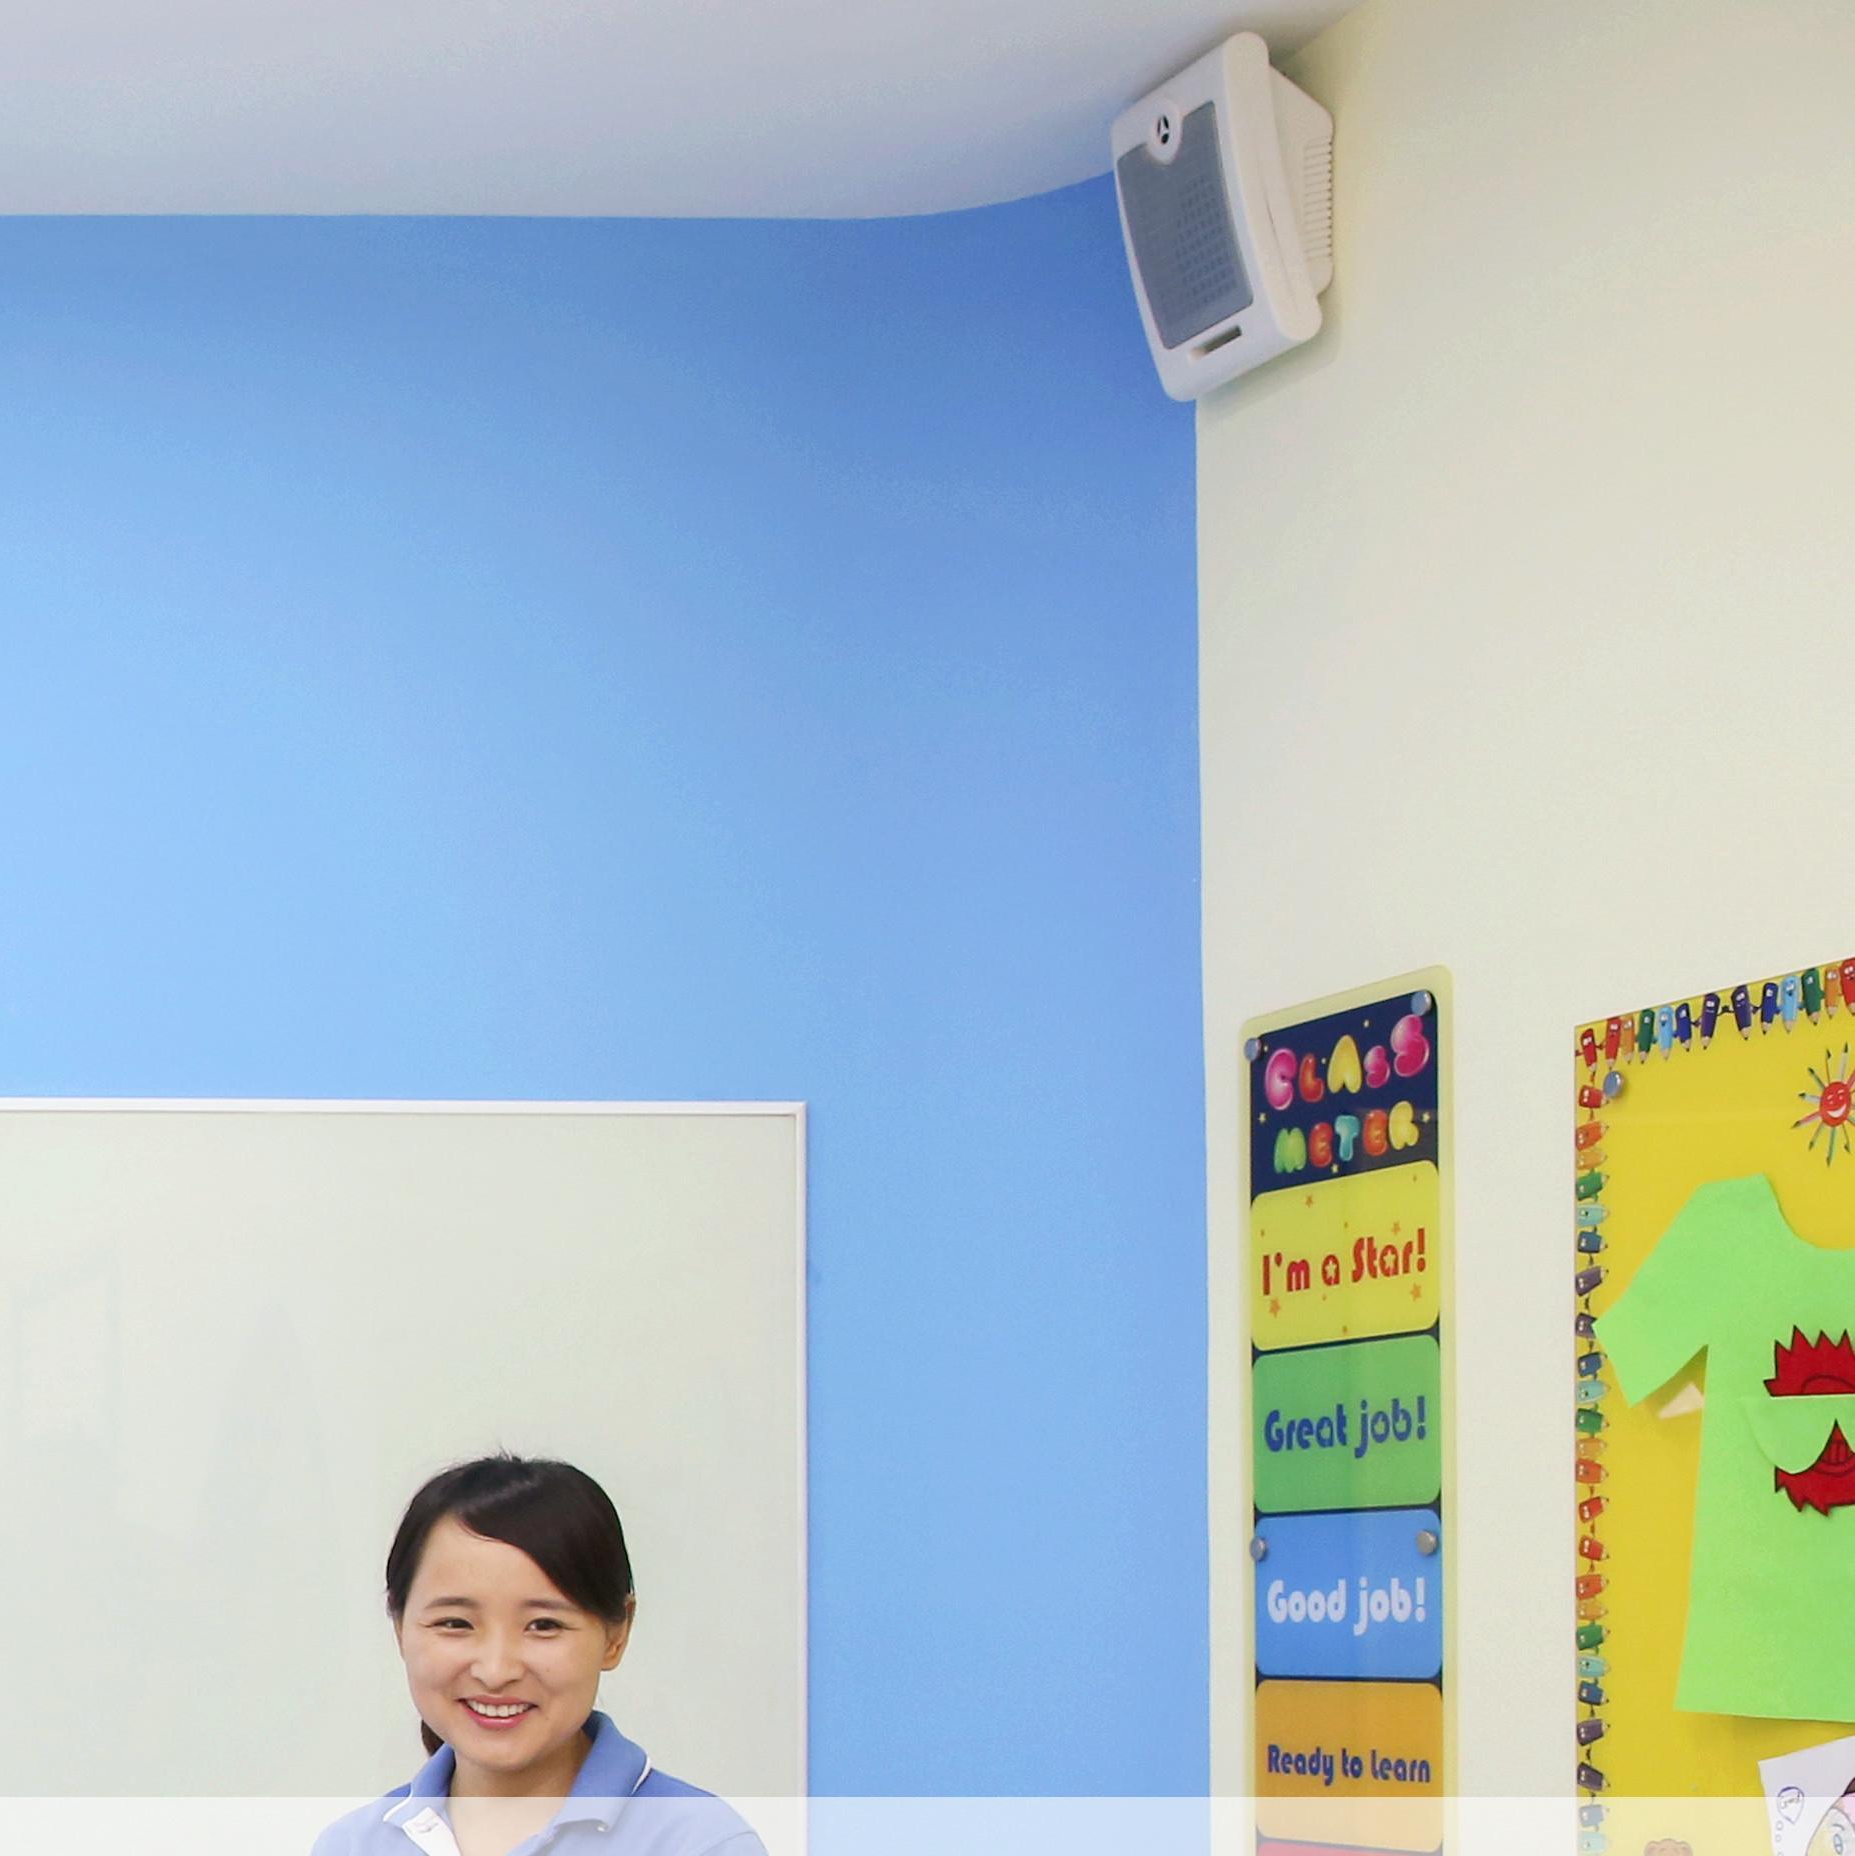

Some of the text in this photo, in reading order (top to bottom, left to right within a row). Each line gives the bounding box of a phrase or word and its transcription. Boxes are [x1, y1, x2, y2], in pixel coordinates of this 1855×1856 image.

[1264, 1013, 1431, 1110] CLASS
[1273, 1100, 1420, 1174] METER
[1263, 1227, 1426, 1296] I'm a Star!
[1264, 1395, 1426, 1459] Great job!
[1267, 1576, 1426, 1636] Good job!
[1267, 1744, 1334, 1786] Ready
[1342, 1748, 1363, 1778] to
